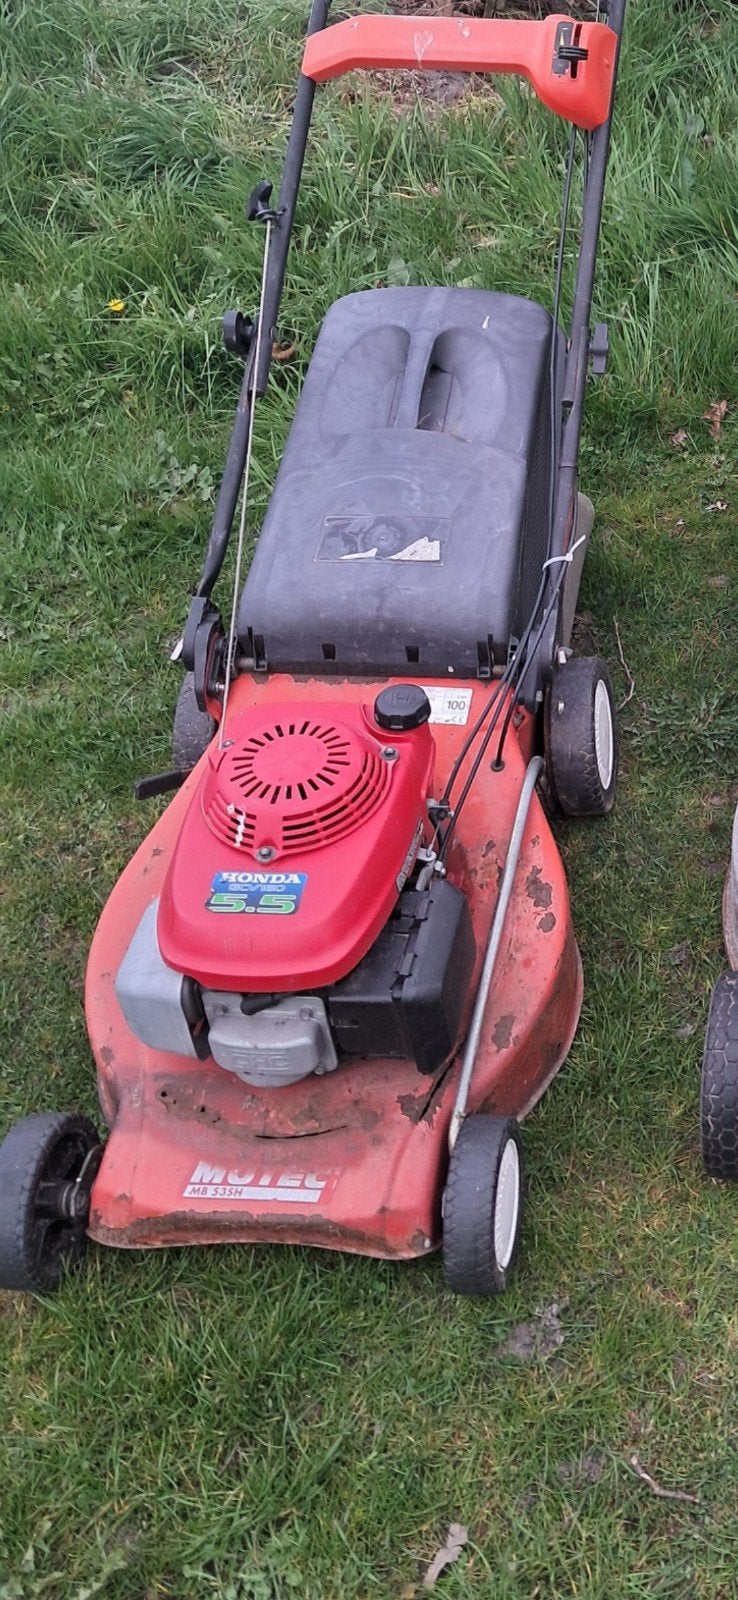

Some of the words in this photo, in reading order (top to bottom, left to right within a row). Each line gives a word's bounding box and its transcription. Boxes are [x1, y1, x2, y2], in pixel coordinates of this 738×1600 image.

[447, 700, 466, 710] 100
[219, 872, 302, 884] HONDA
[206, 893, 297, 914] 5.5
[189, 1186, 208, 1196] MB
